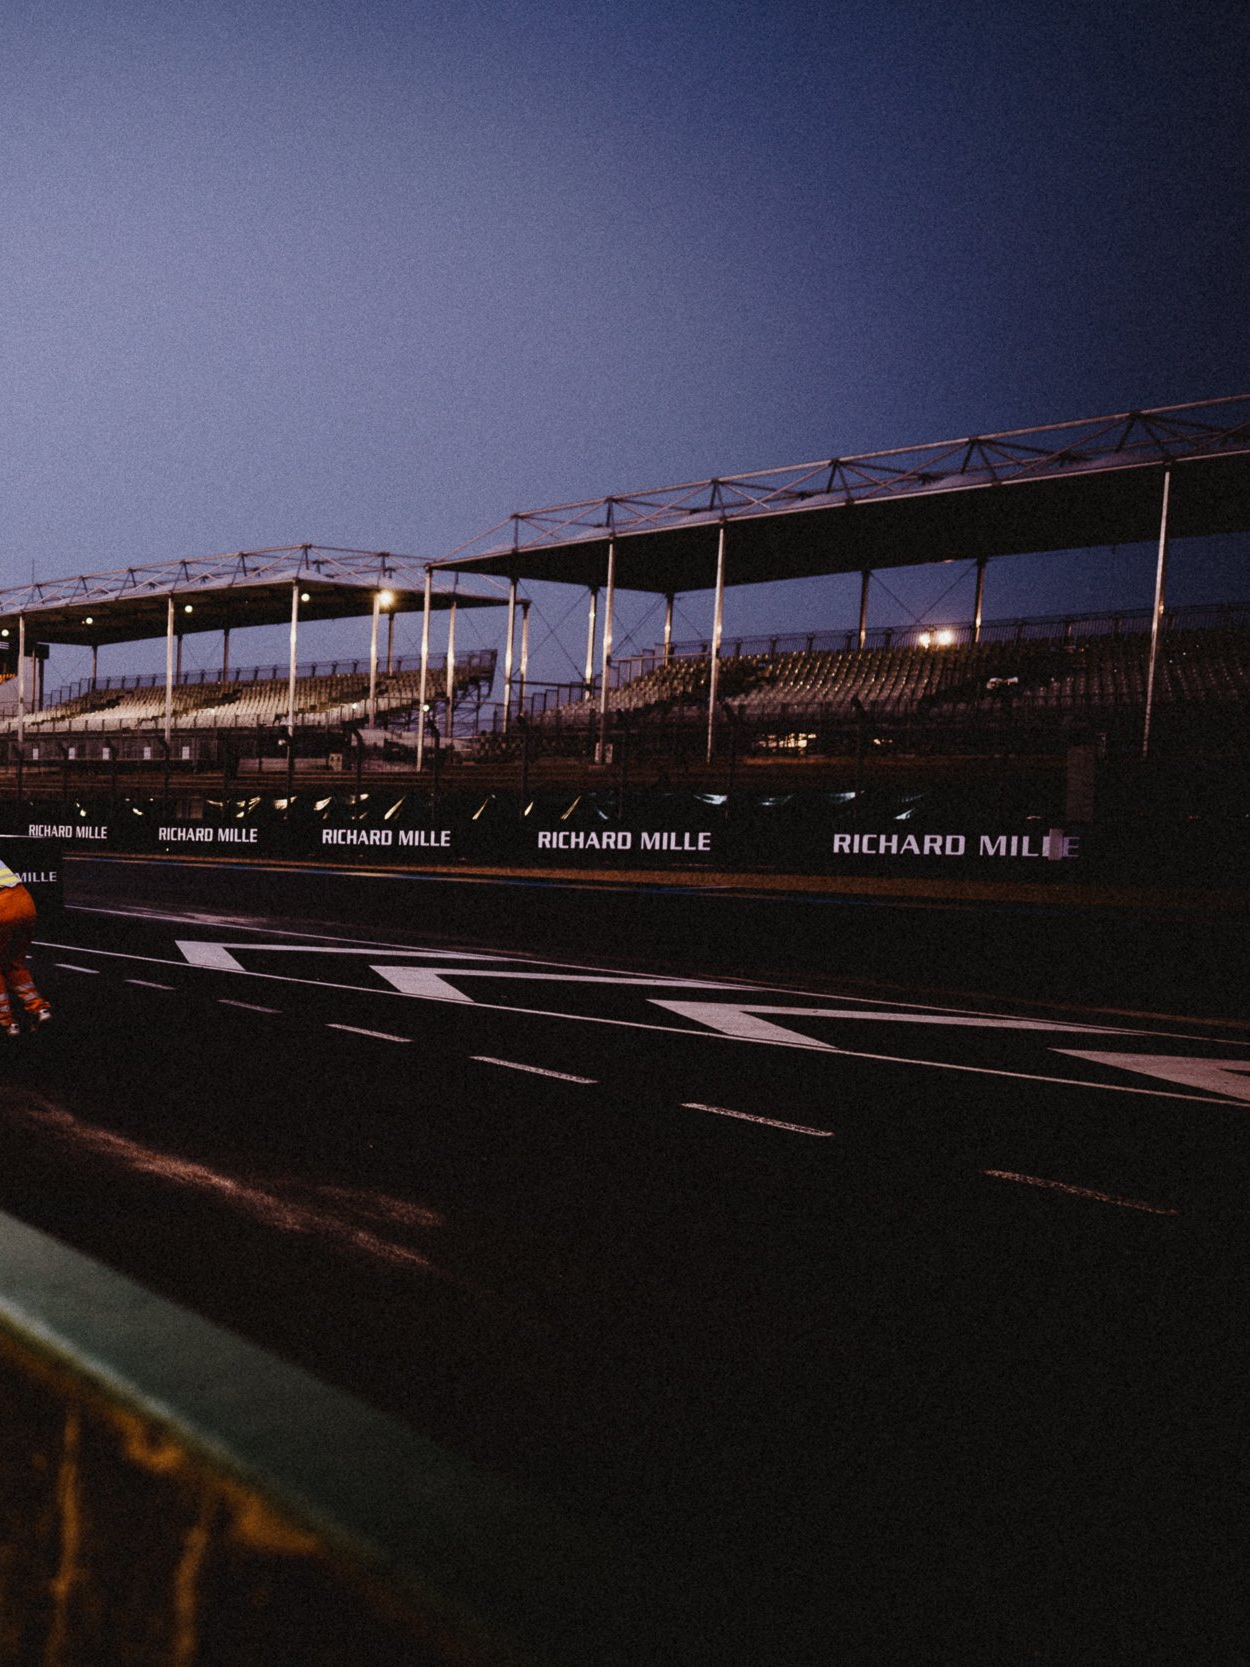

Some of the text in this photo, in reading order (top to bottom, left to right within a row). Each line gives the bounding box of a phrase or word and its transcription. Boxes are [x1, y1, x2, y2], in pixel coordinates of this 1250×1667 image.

[28, 824, 108, 840] RICHARD MILLE
[158, 826, 258, 843] RICHARD MILLE
[321, 828, 451, 847] RICHARD MILLE
[537, 831, 712, 852] RICHARD MILLE
[833, 833, 966, 857] RICHARD
[14, 872, 57, 883] MILLE
